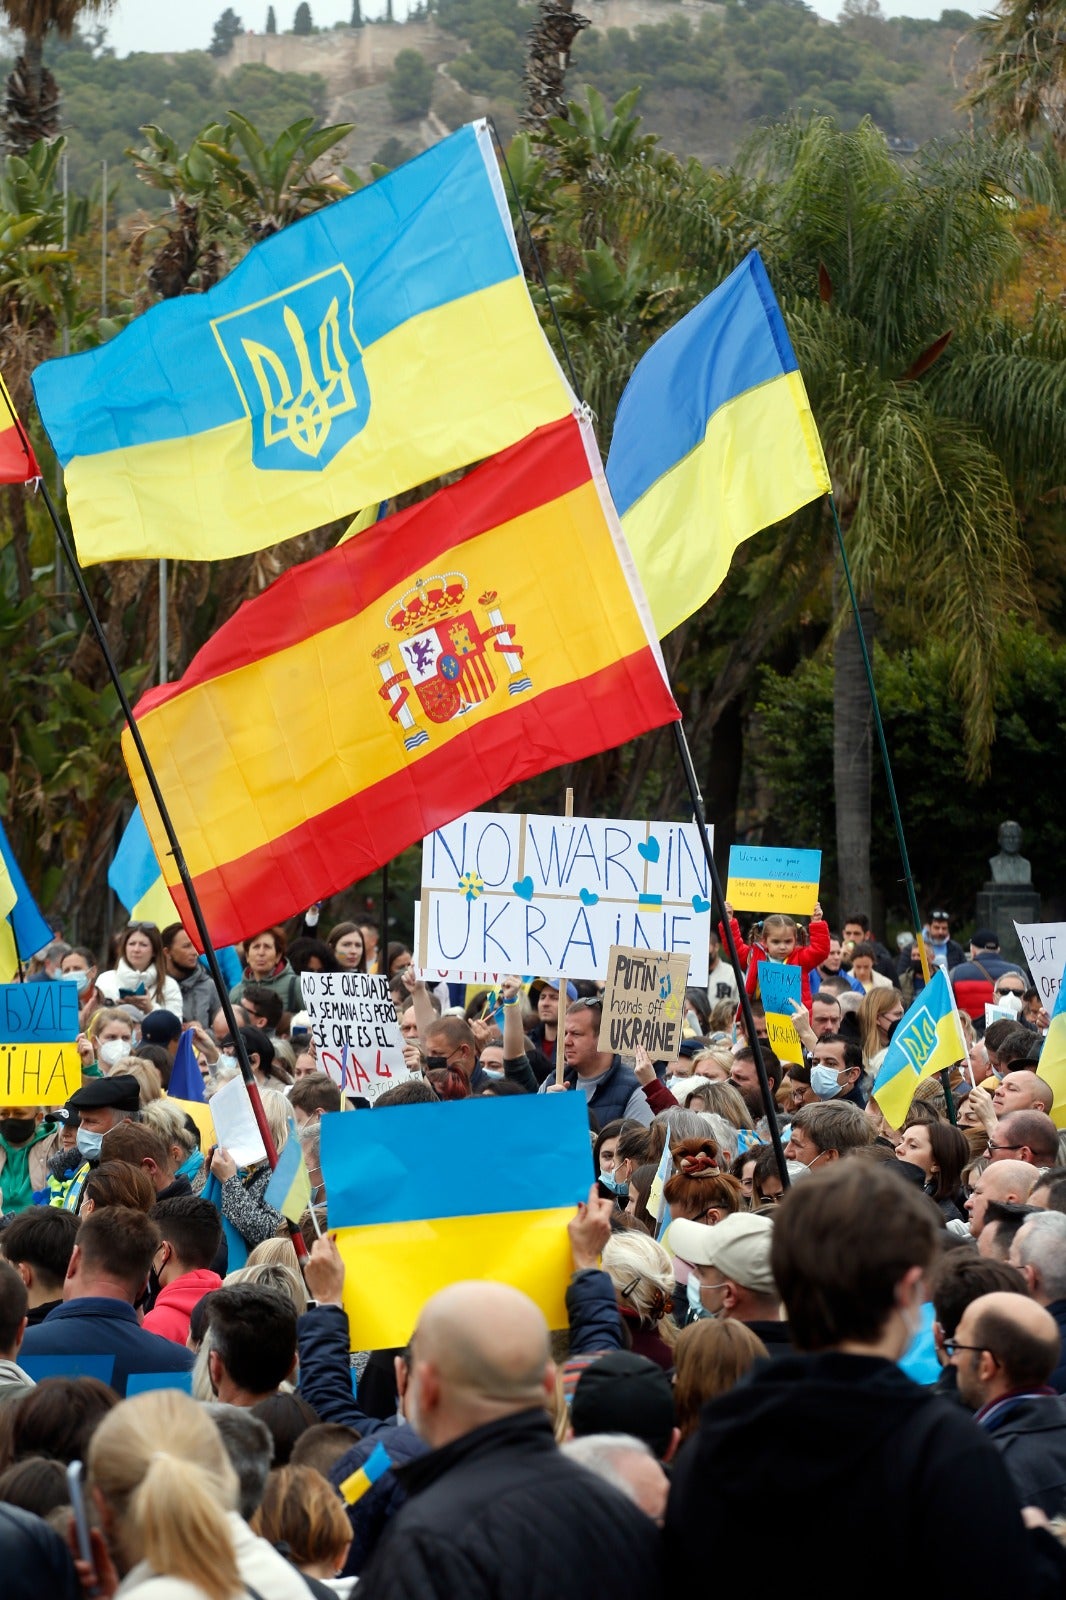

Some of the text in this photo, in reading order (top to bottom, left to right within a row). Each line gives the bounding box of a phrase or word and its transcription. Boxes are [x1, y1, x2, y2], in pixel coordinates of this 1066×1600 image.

[432, 822, 511, 887] NO
[528, 824, 639, 893] WAR
[302, 976, 316, 996] NO
[320, 973, 335, 996] SÉ
[341, 974, 360, 999] QUE
[379, 977, 392, 1002] DE
[5, 984, 77, 1037] БУДЕ
[308, 1001, 398, 1024] LA SEMANA ES PERO
[610, 988, 665, 1017] hands off
[311, 1019, 395, 1048] SÉ QUE ES EL
[375, 1050, 392, 1078] 4
